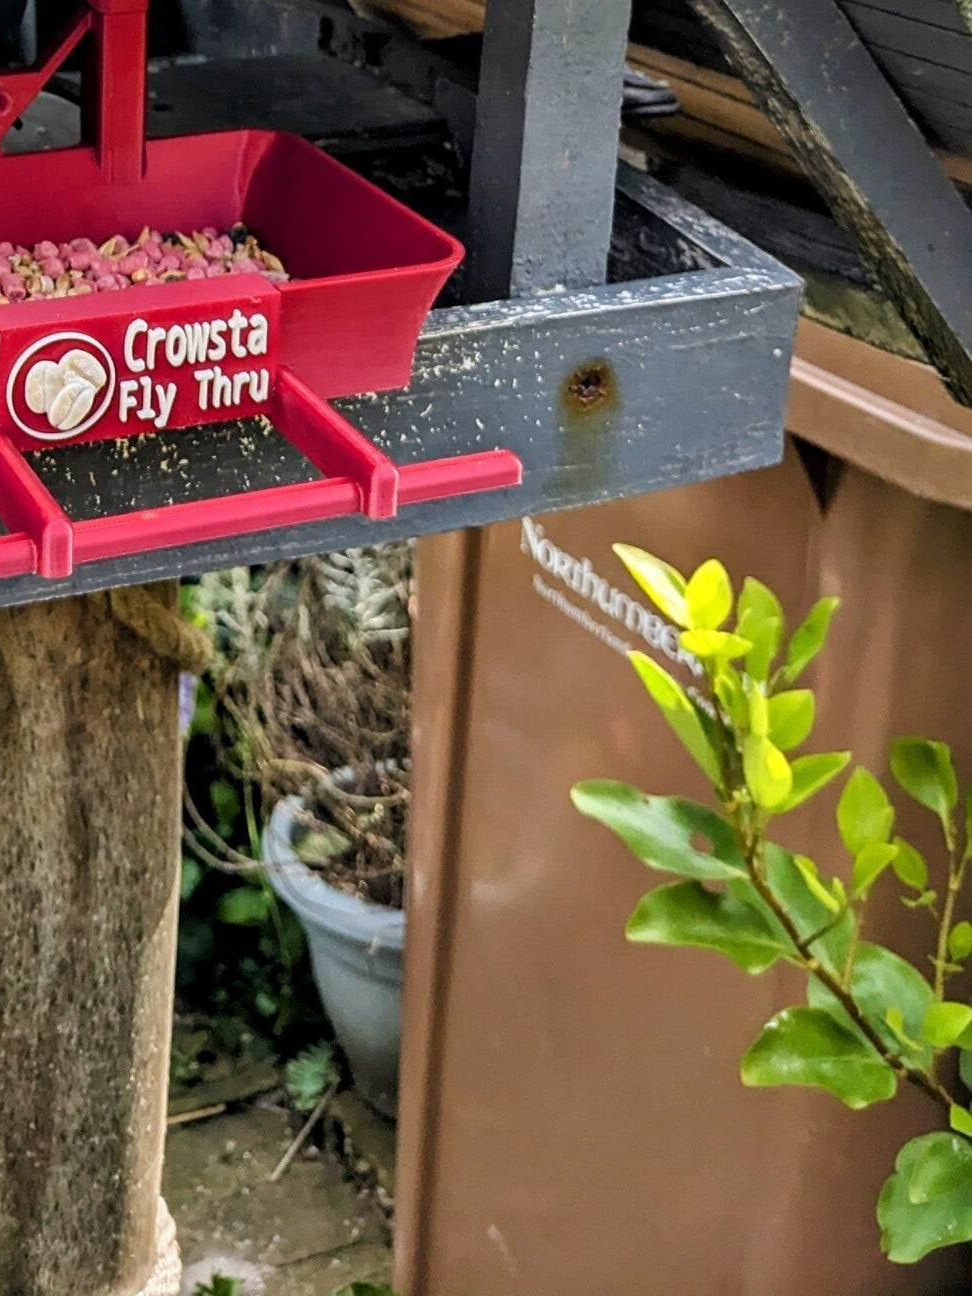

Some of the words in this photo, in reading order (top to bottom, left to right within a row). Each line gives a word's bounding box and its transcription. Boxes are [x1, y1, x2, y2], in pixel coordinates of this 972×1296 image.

[123, 307, 269, 373] Crowsta
[118, 375, 177, 429] Fly
[193, 365, 270, 411] Thru
